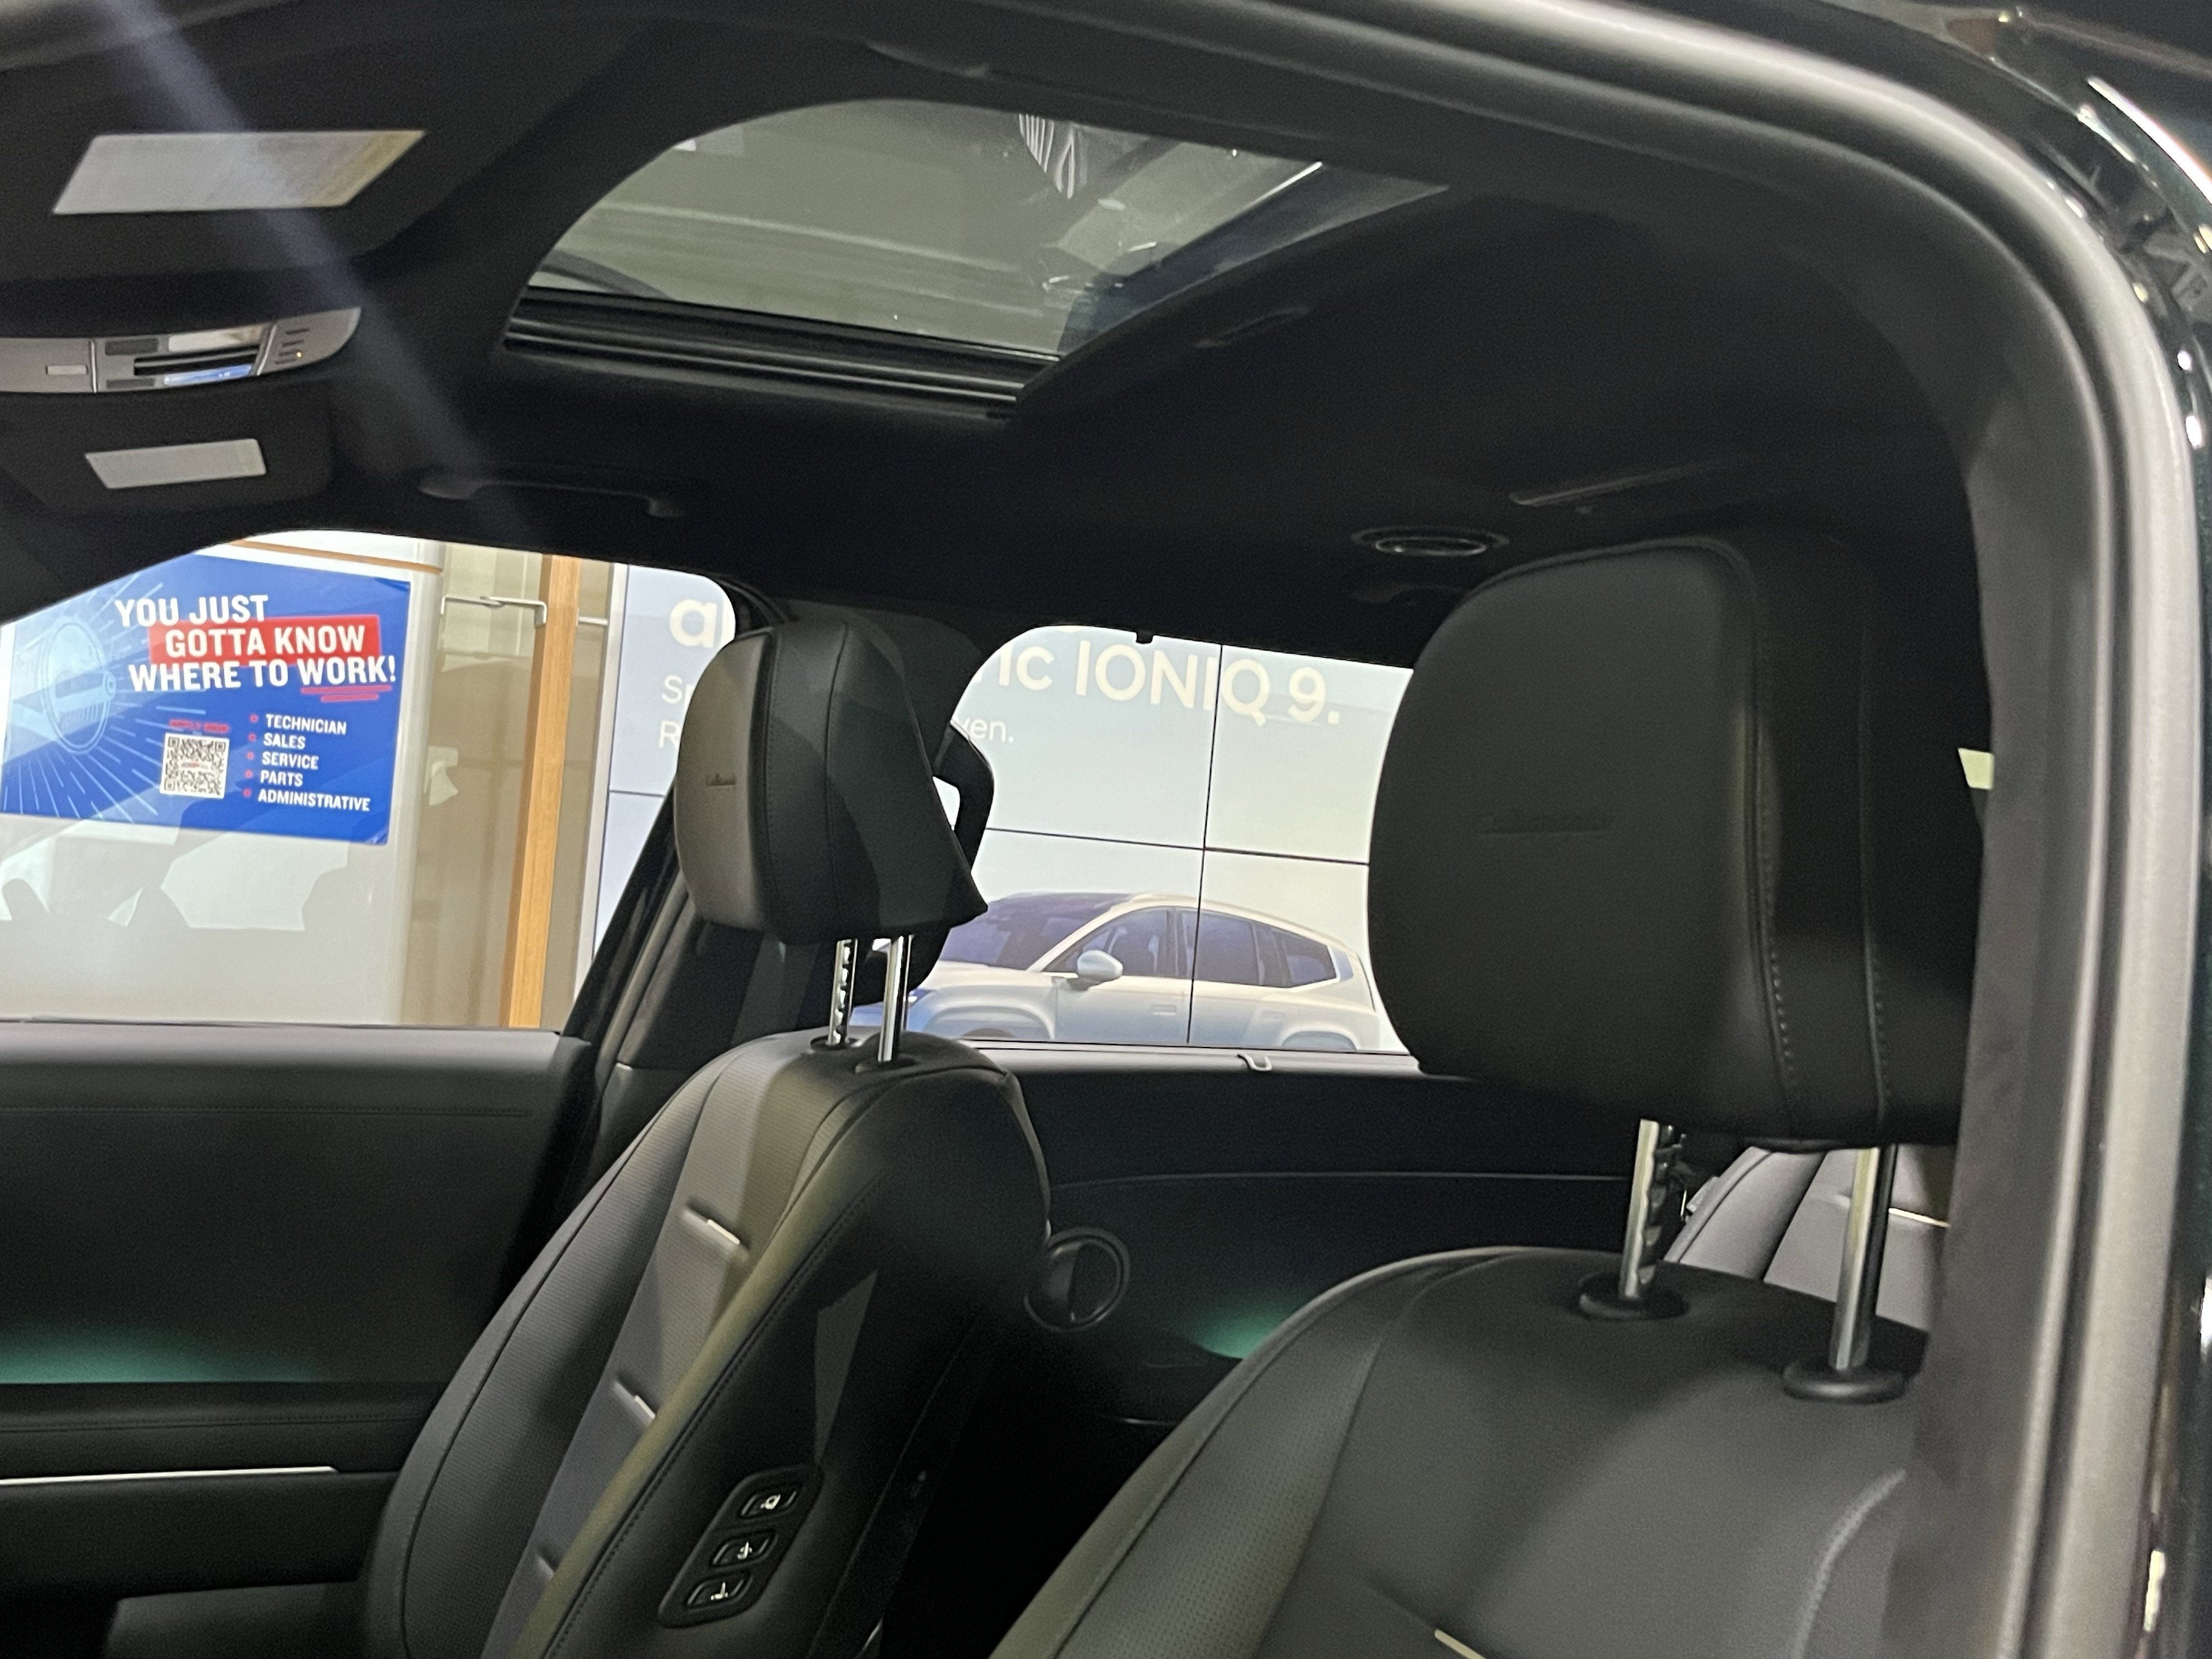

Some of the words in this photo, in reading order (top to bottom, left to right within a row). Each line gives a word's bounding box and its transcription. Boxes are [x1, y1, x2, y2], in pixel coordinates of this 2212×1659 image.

[115, 597, 179, 627] YOU
[189, 595, 269, 625] JUST
[165, 628, 267, 658] GOTTA
[274, 624, 365, 656] KNOW
[128, 661, 241, 692] WHERE
[248, 658, 289, 687] TO
[297, 655, 396, 686] WORK!
[972, 641, 1054, 690] ic
[1075, 640, 1270, 726] IONIQ
[1287, 667, 1340, 724] 9.
[266, 713, 347, 735] TECHNICIAN
[659, 719, 681, 748] R
[263, 732, 306, 750] SALES
[262, 752, 319, 771] SERVICE
[260, 770, 304, 787] PARTS
[258, 789, 371, 812] ADMINISTRATIVE
